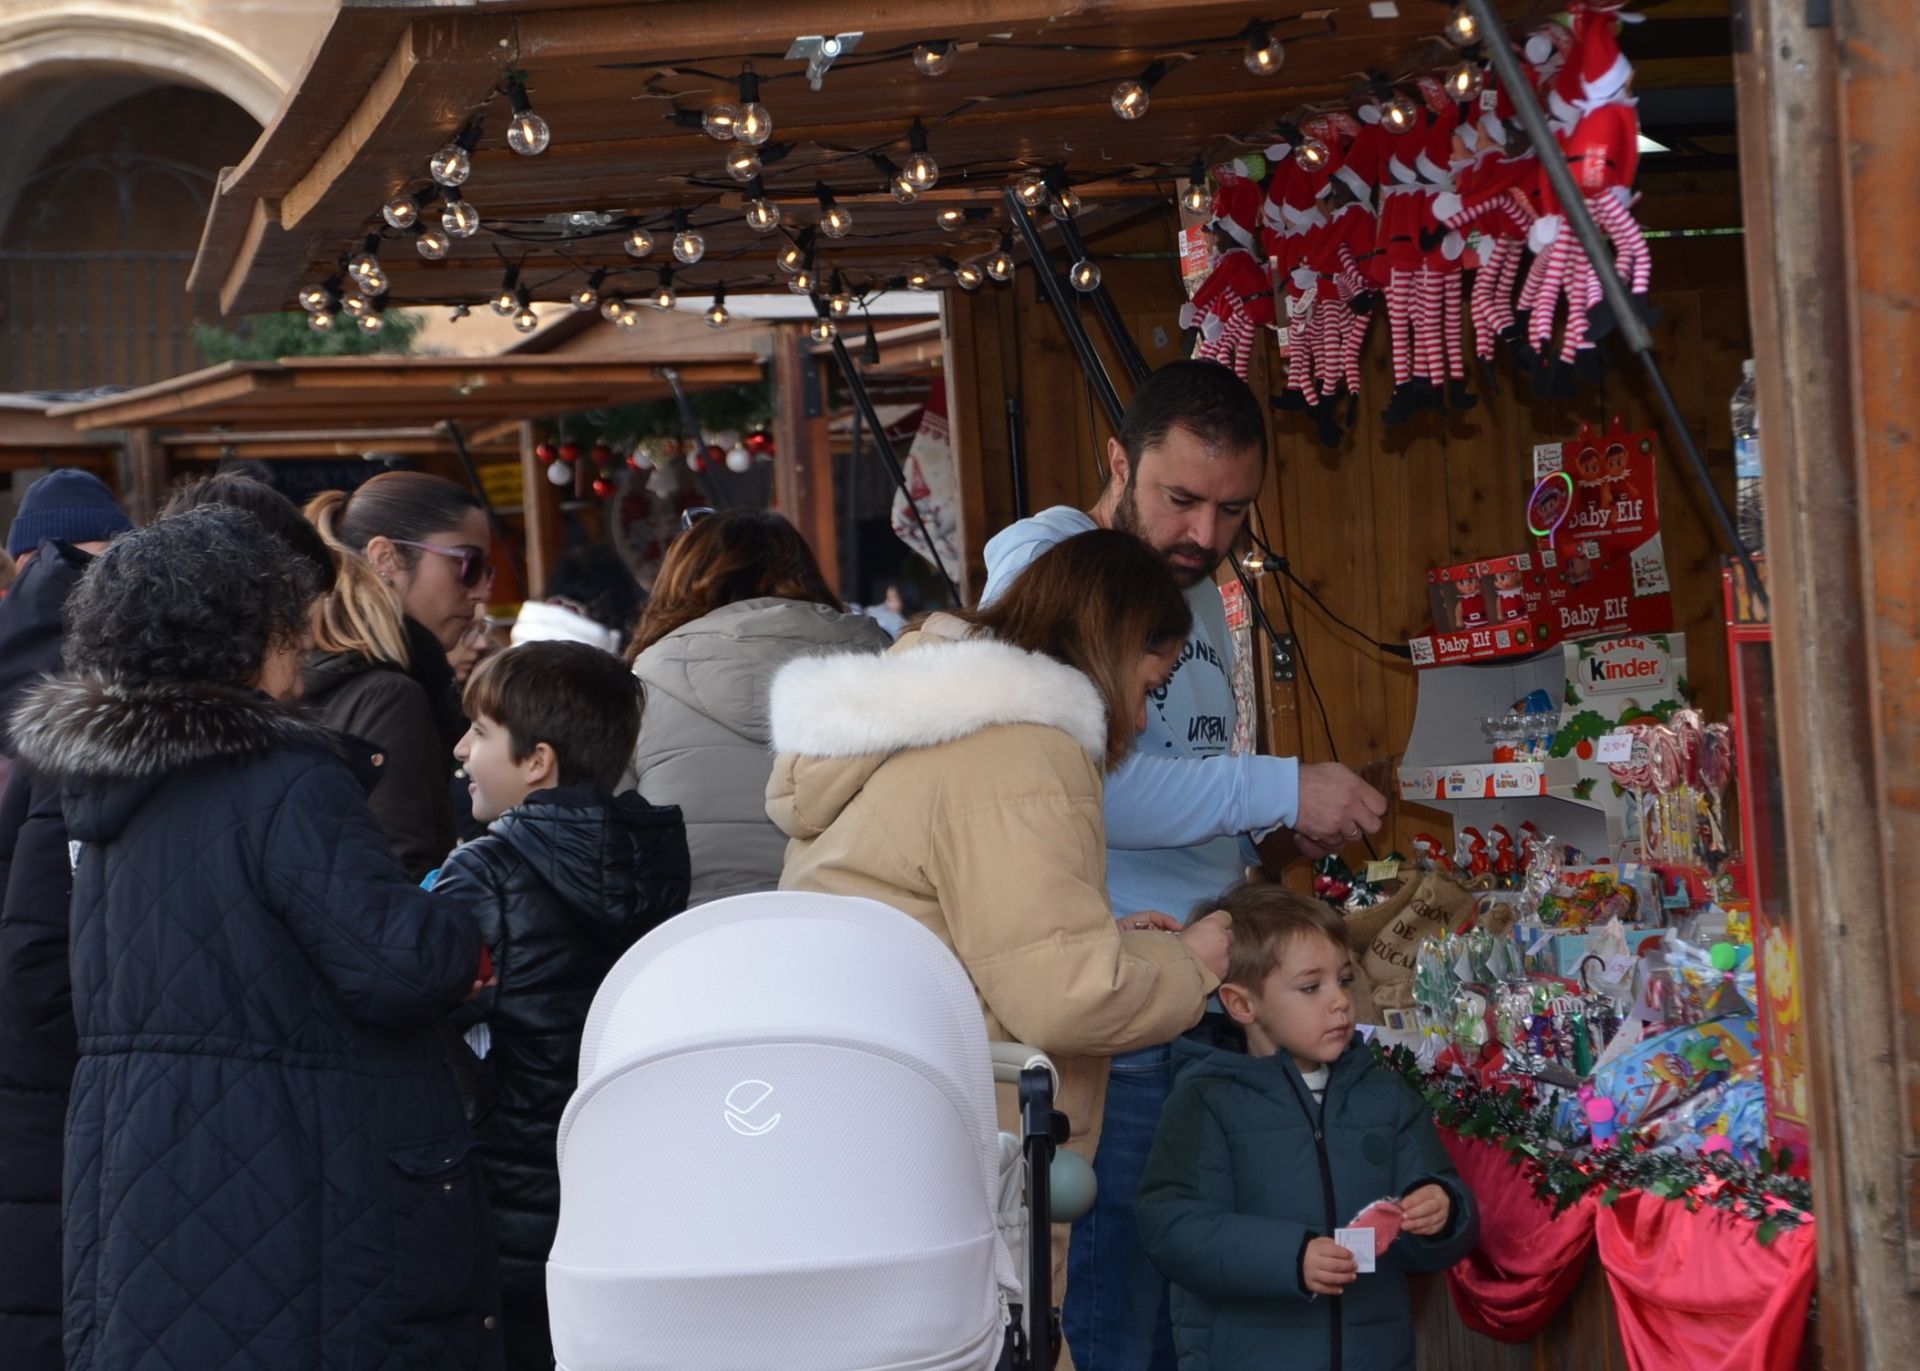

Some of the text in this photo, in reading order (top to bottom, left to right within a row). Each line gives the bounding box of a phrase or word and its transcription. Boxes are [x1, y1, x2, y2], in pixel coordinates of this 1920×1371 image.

[1617, 499, 1643, 522] Elf
[1559, 597, 1628, 628] Baby Elf
[1437, 636, 1469, 654] Baby
[1472, 631, 1491, 648] Elf
[1601, 638, 1645, 654] LA CASA
[1392, 920, 1416, 941] DE
